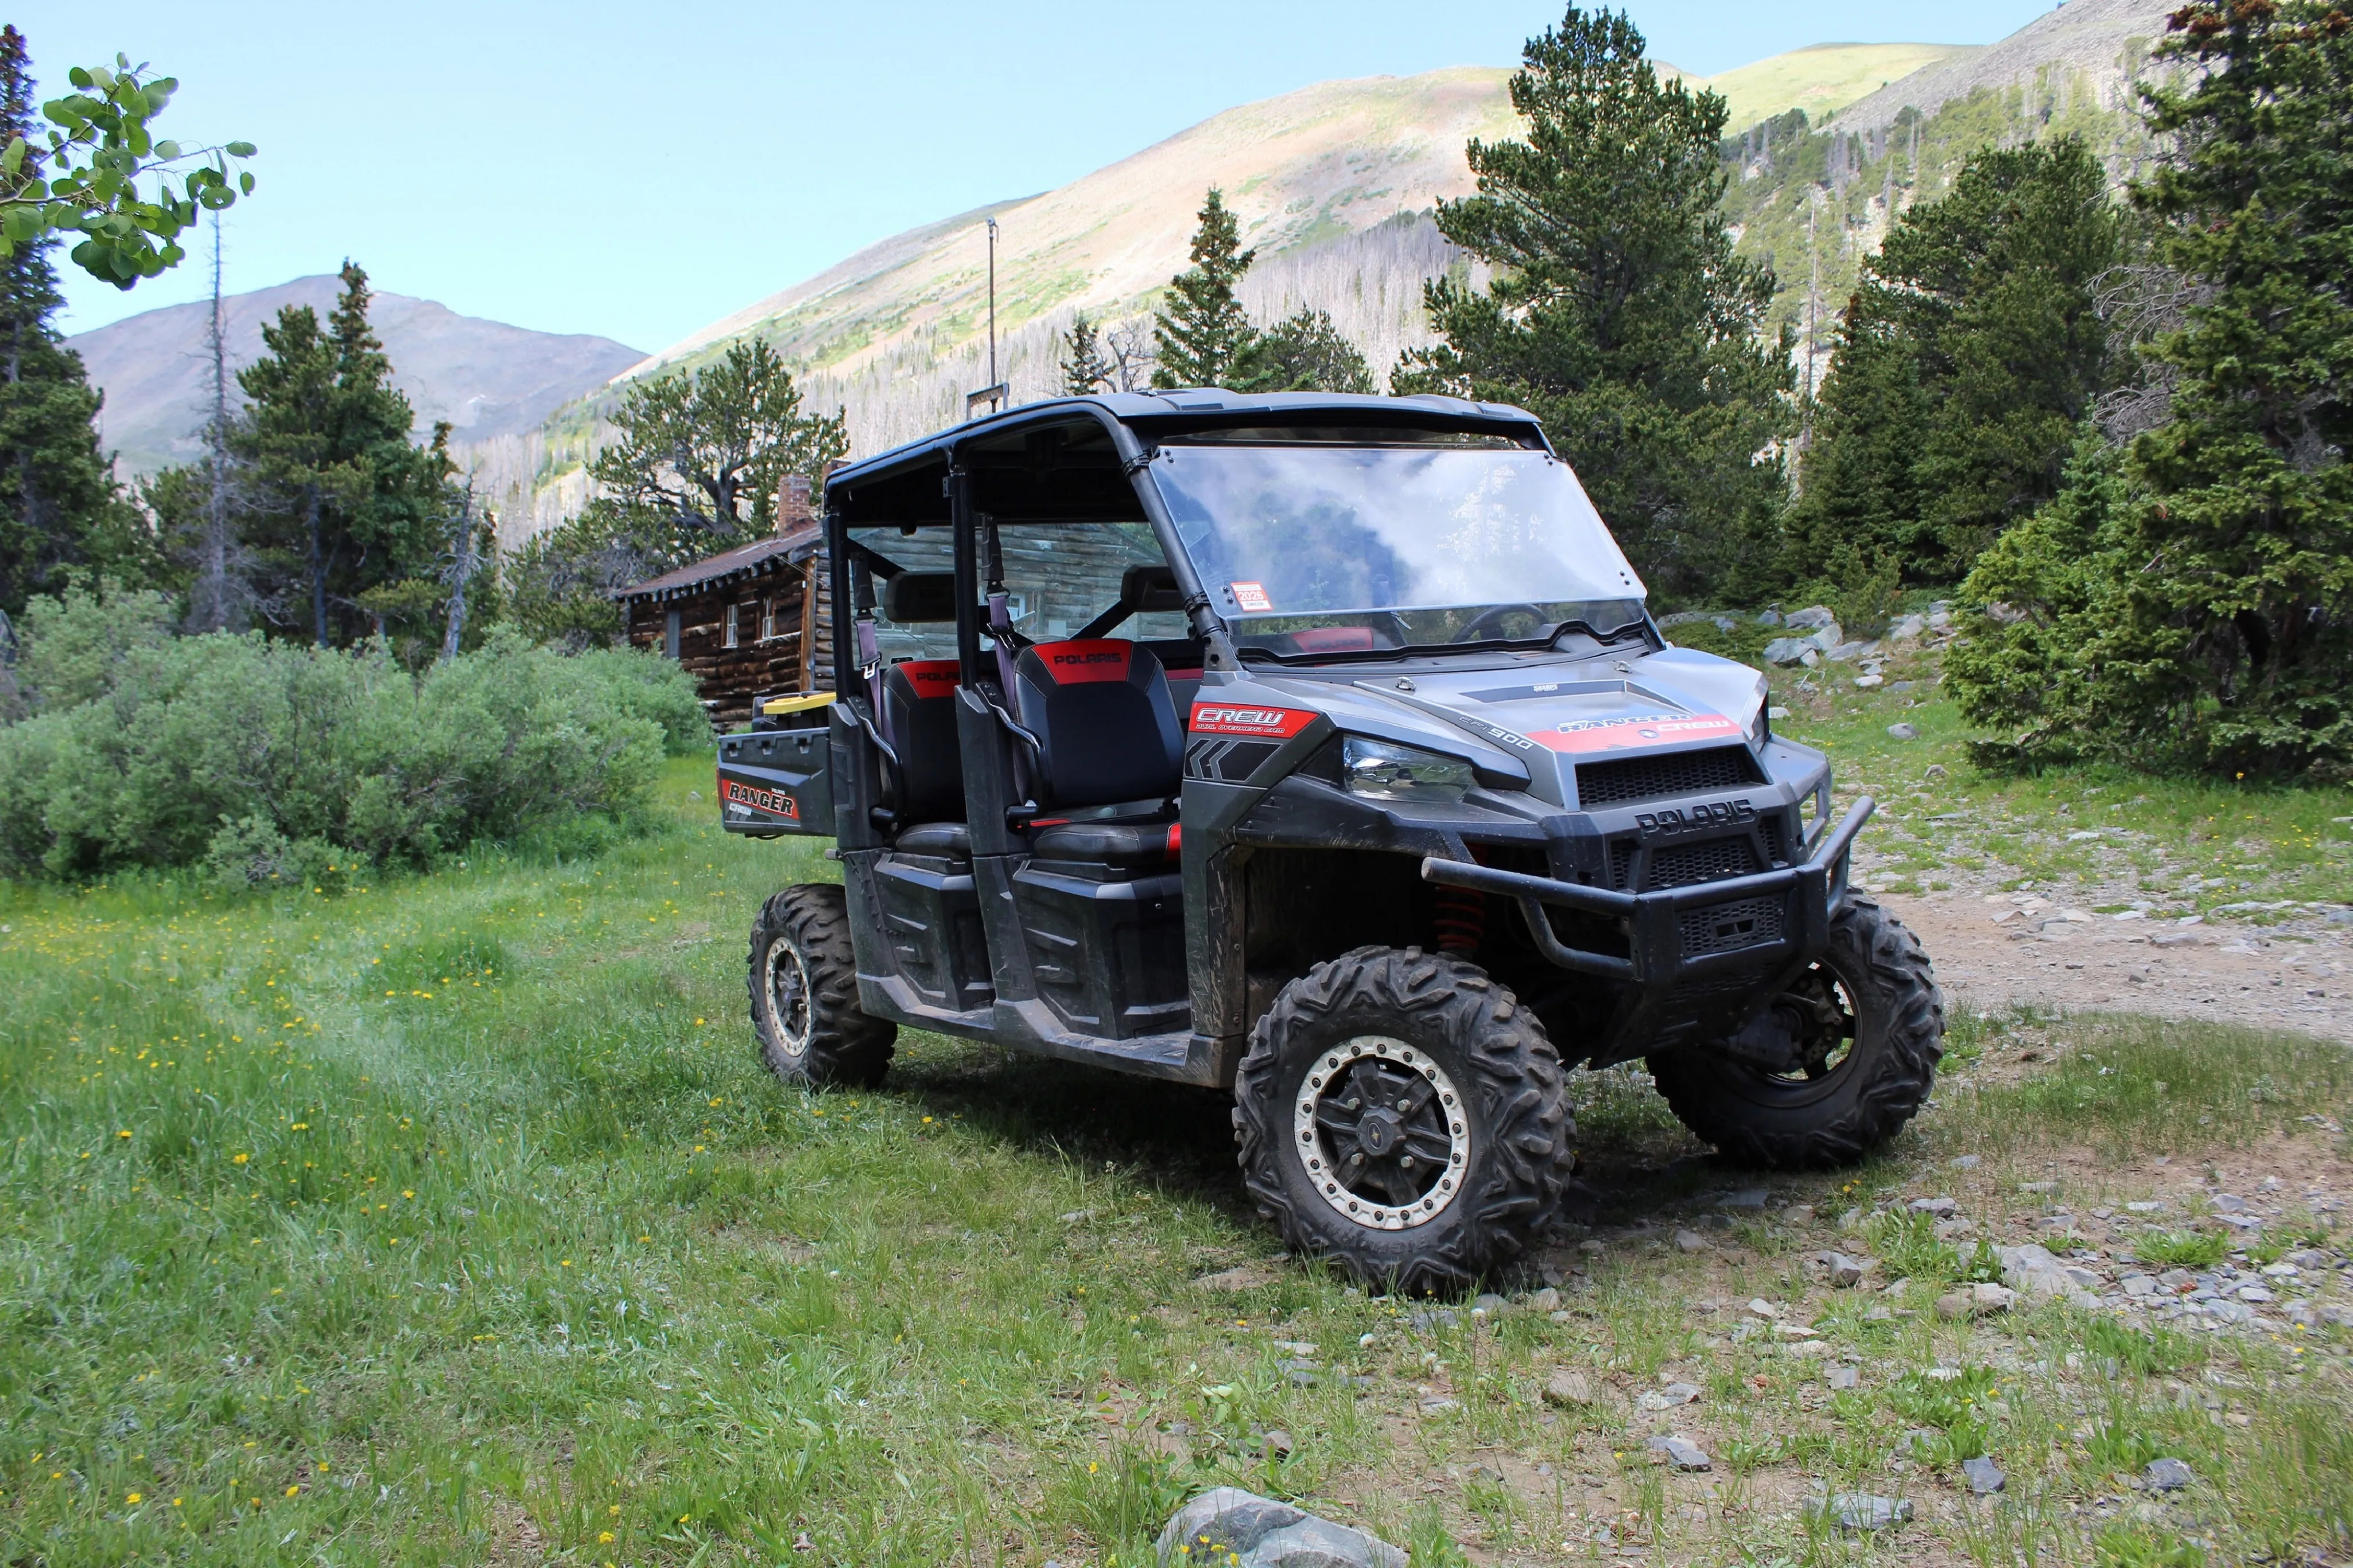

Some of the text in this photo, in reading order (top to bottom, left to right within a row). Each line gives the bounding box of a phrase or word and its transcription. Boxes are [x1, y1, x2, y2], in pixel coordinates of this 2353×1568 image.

[1054, 653, 1122, 665] POLARIS
[1197, 708, 1285, 726] CREW
[1557, 715, 1692, 734] RANGER
[1656, 721, 1730, 731] CREW
[1458, 716, 1534, 750] EFI 900
[728, 782, 794, 816] RANGER
[729, 802, 752, 816] CREW
[1634, 799, 1755, 839] POLARIS
